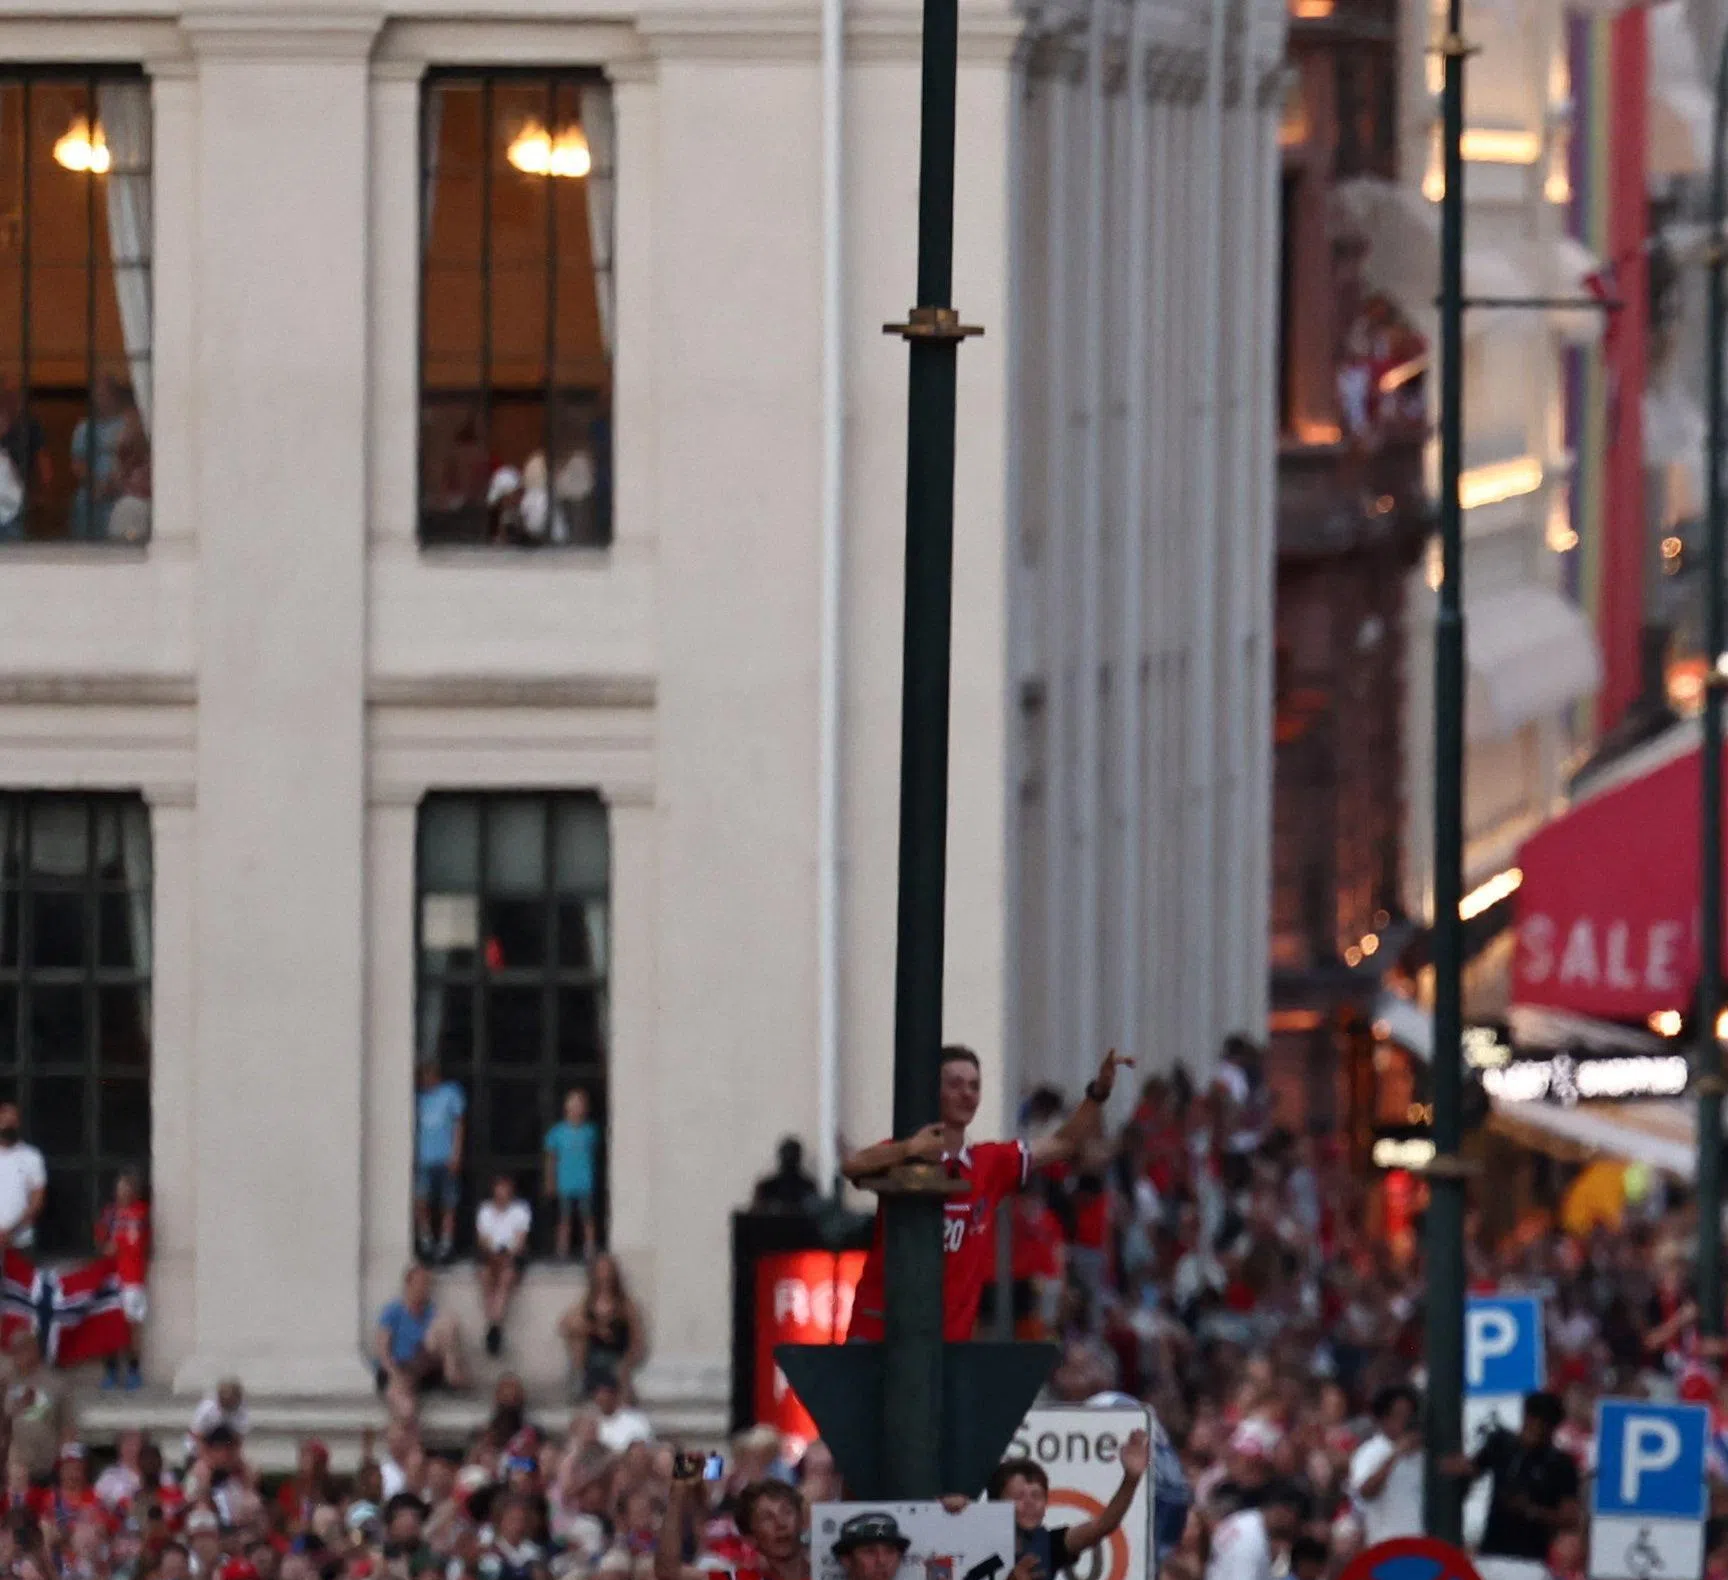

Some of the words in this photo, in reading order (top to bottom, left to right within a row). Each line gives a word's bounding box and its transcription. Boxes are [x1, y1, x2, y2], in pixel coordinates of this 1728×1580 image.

[1518, 911, 1683, 993] SALE
[1465, 1308, 1519, 1387] P
[1620, 1416, 1681, 1503] P
